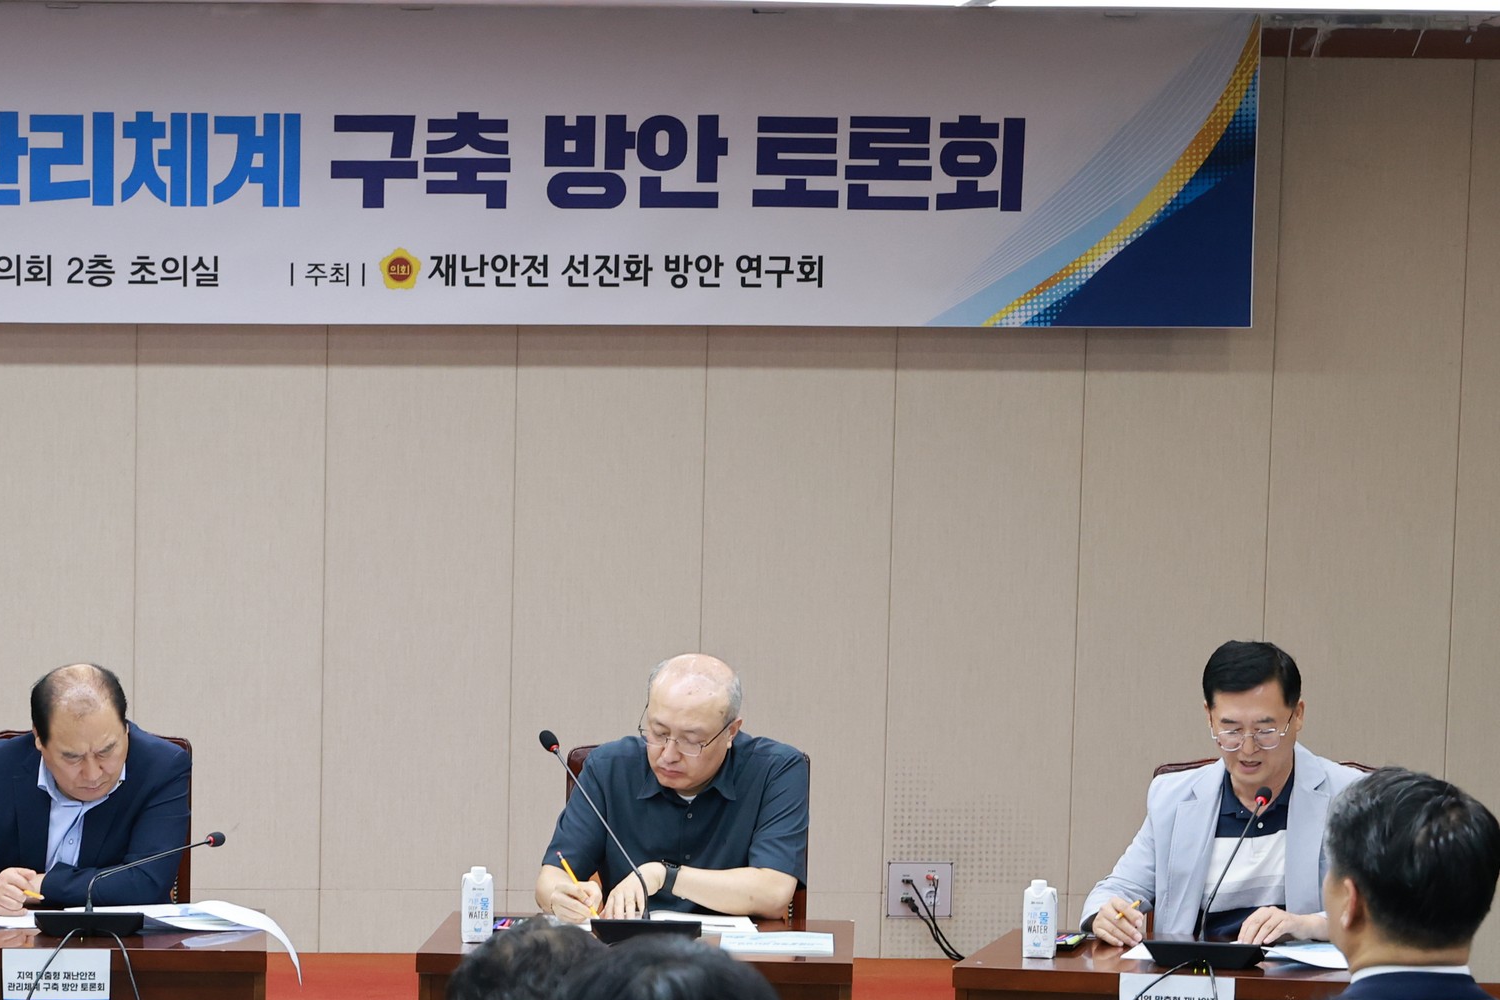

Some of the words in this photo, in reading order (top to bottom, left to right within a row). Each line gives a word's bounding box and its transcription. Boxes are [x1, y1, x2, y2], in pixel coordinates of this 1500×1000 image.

[331, 112, 511, 209] 구축
[544, 114, 728, 209] 방안
[752, 115, 1026, 212] 토론회
[67, 255, 115, 287] 2층
[128, 255, 218, 287] 초의실
[305, 263, 349, 286] 주최
[389, 264, 410, 276] 의회
[428, 254, 548, 287] 재난안전
[561, 254, 653, 287] 선진화
[665, 255, 724, 288] 방안
[736, 255, 823, 288] 연구회
[468, 911, 488, 919] WATER
[1028, 926, 1048, 934] WATER
[17, 972, 33, 980] 지역
[63, 972, 95, 980] 재난안전
[43, 983, 59, 991] 구축
[62, 983, 78, 991] 방안
[81, 983, 104, 991] 토론회
